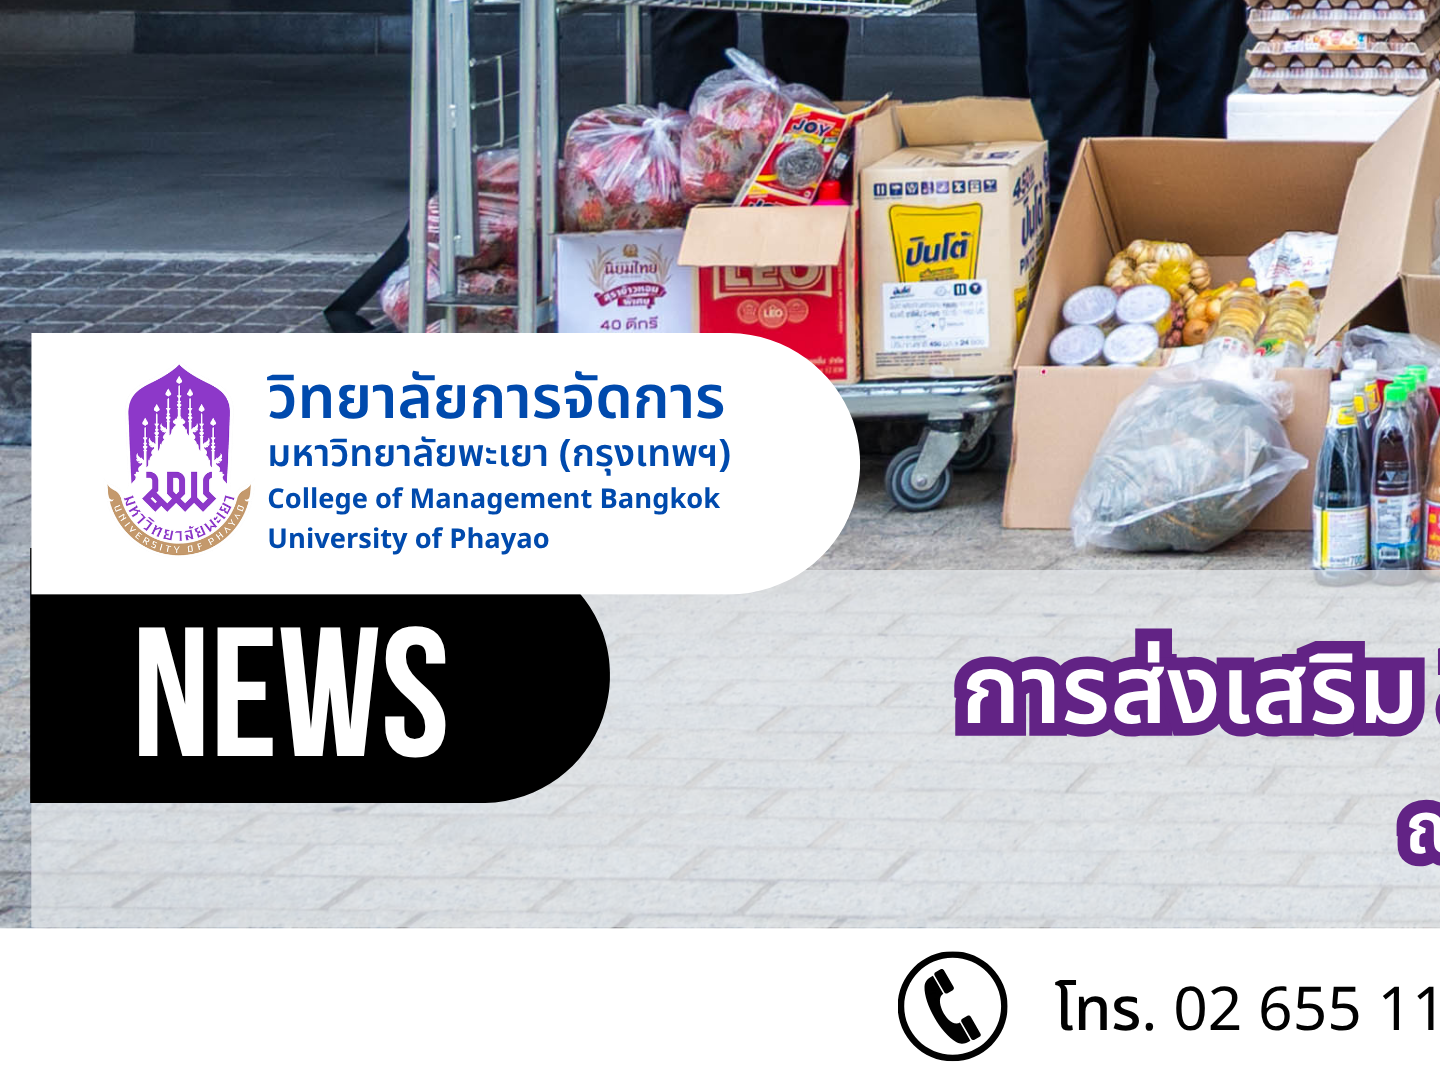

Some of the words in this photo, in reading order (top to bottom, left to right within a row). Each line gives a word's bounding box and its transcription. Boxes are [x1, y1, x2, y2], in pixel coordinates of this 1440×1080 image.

[792, 119, 832, 138] JOY
[605, 260, 658, 275] นิยมไทย
[763, 307, 783, 319] LEO
[600, 319, 622, 331] 40
[625, 316, 659, 331] ดีกรี
